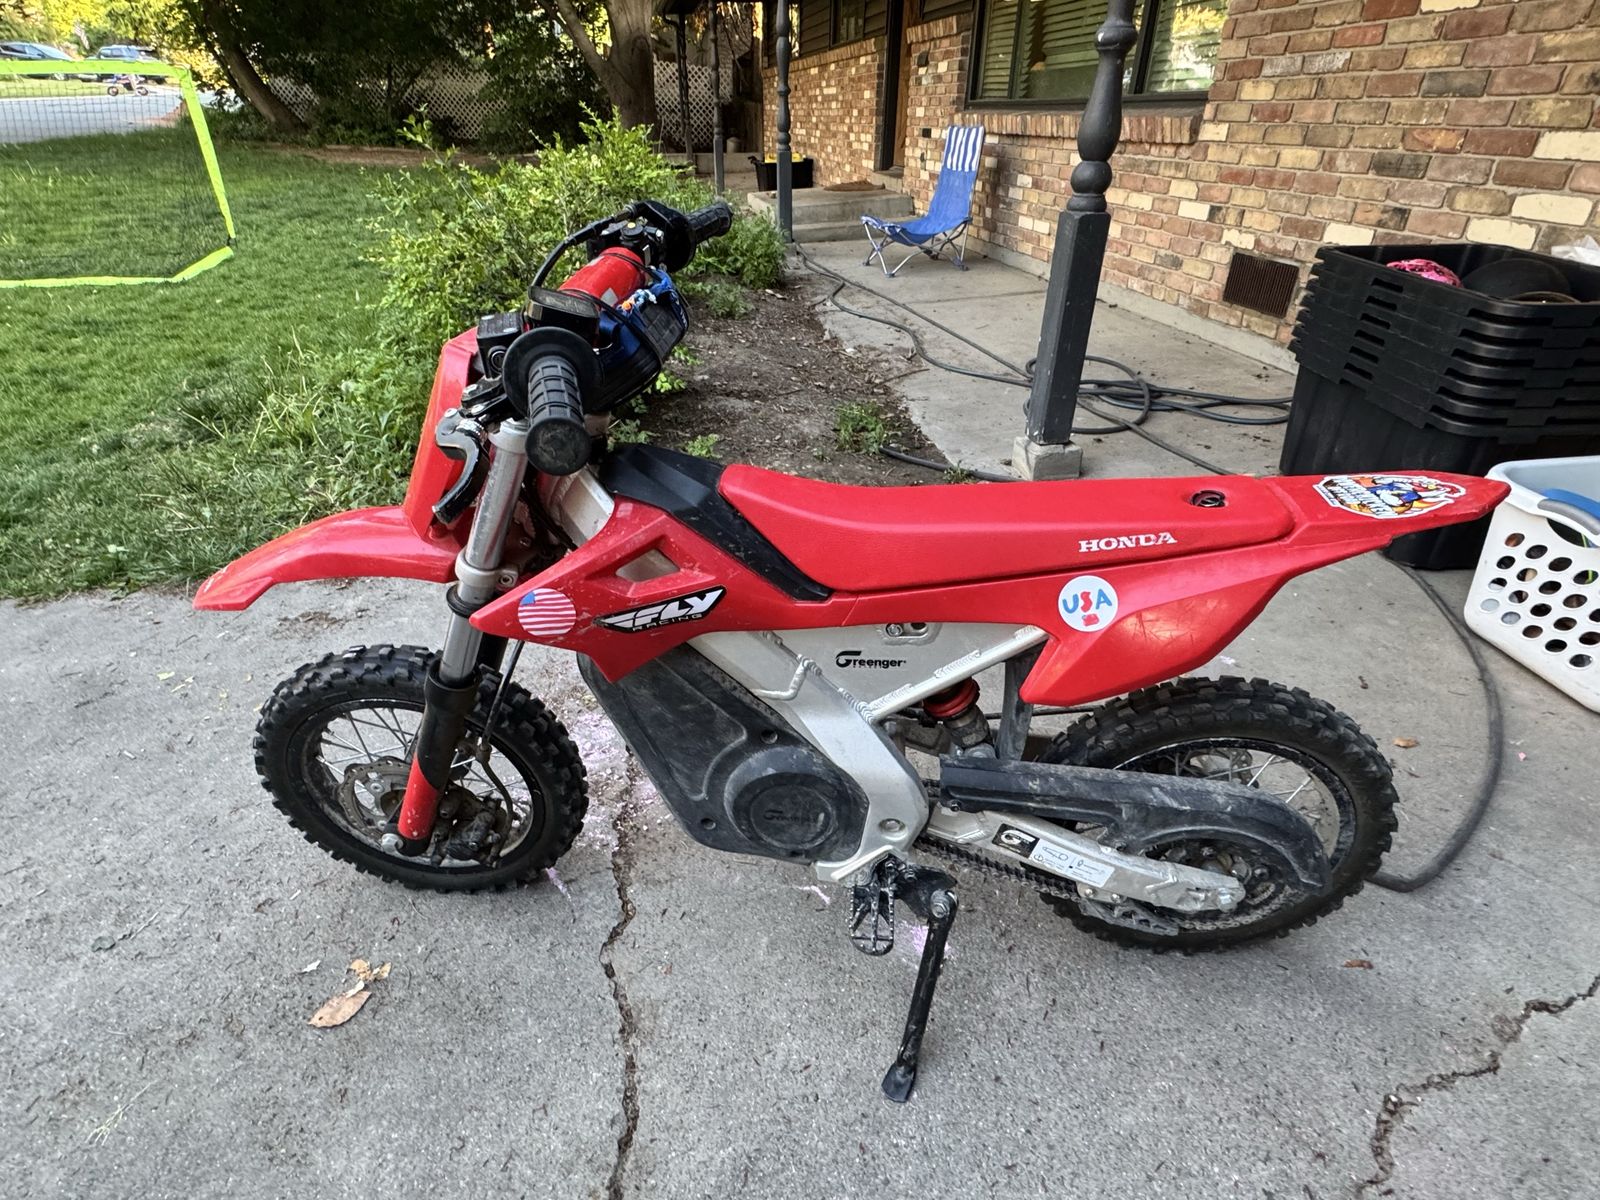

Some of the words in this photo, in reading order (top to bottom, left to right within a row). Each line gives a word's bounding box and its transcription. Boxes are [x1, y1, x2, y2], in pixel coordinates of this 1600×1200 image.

[1079, 531, 1178, 552] HONDA
[602, 589, 724, 628] FLY
[1062, 588, 1113, 614] USA
[632, 613, 703, 632] RACING
[835, 650, 905, 669] Greenger
